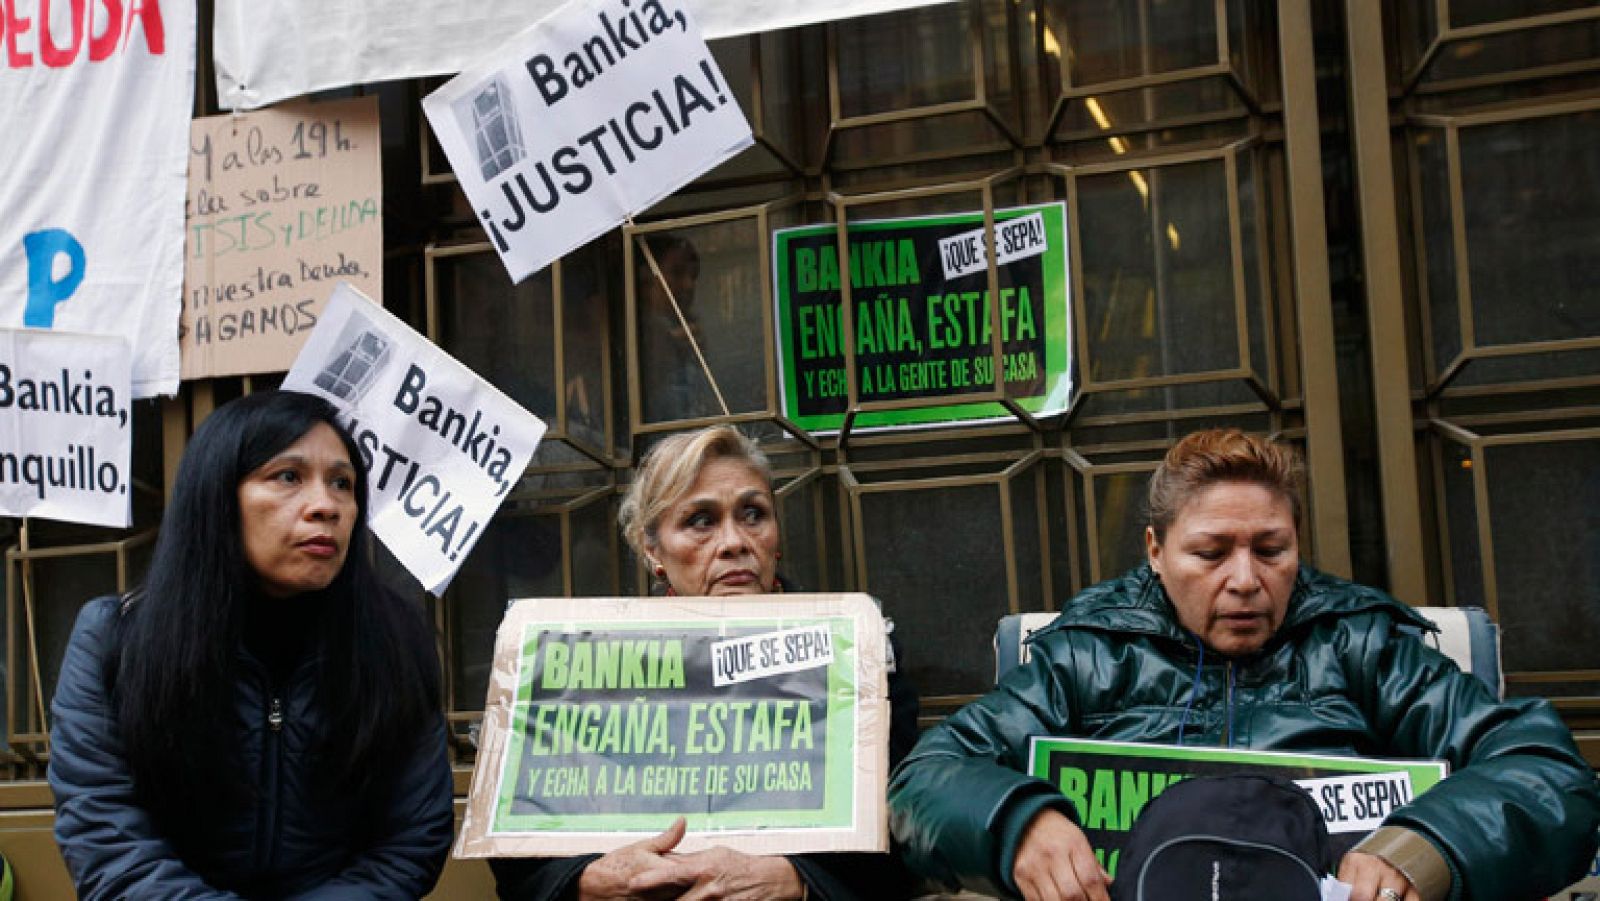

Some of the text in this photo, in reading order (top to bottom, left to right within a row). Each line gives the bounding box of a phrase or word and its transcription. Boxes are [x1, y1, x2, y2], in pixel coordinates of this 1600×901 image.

[0, 0, 165, 68] EUDA
[525, 0, 687, 107] Bankia,
[481, 60, 728, 253] ¡JUSTICIA!
[240, 174, 322, 206] sobre
[1002, 218, 1043, 255] SEPA!
[180, 300, 318, 345] AGAMOS
[804, 369, 815, 399] Y
[819, 368, 849, 398] ECH
[862, 366, 873, 394] A
[876, 364, 896, 393] LA
[900, 360, 947, 392] GENTE
[951, 358, 971, 387] DE
[974, 355, 995, 385] SU
[394, 363, 513, 497] Bankia,
[541, 629, 830, 690] BANKIA ¡QUE SE SEPA!
[532, 697, 814, 760] ENGAÑA, ESTAFA
[528, 760, 812, 798] Y ECHA A LA GENTE DE SU CASA
[1321, 784, 1348, 822] SE
